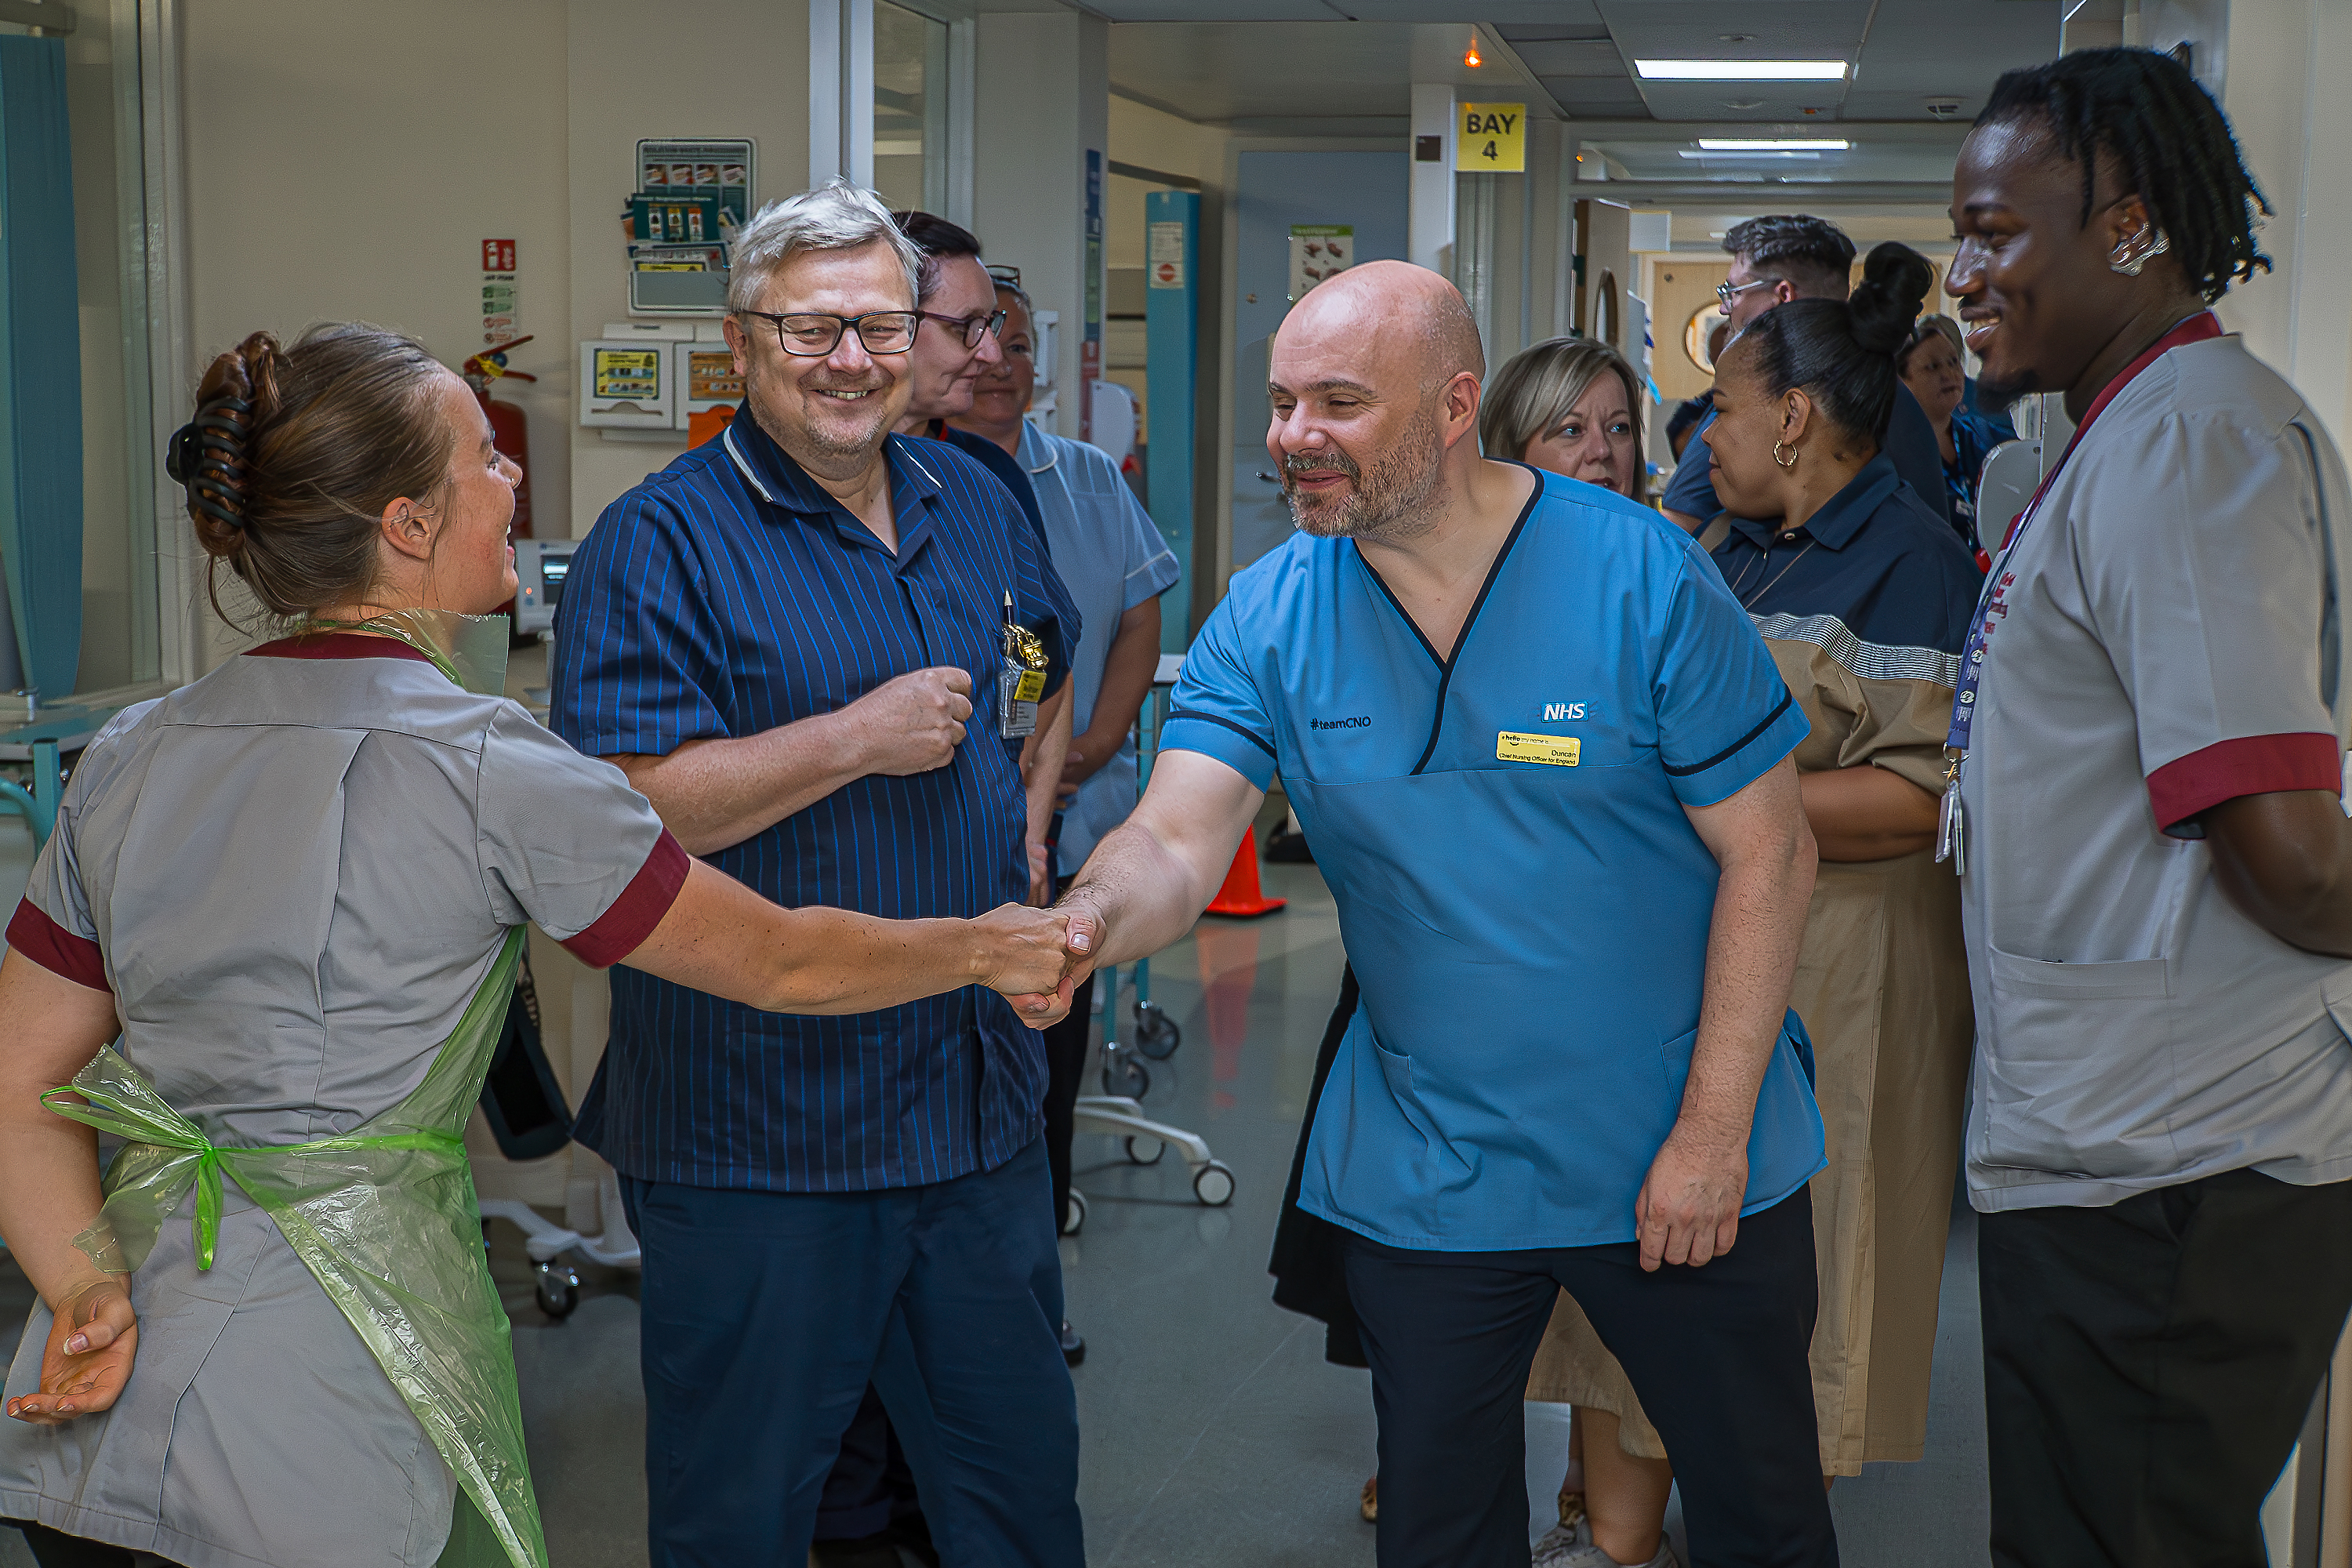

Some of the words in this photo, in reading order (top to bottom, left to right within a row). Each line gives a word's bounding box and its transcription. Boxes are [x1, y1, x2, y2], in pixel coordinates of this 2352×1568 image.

[1467, 113, 1517, 135] BAY
[1482, 140, 1498, 161] 4
[1544, 703, 1585, 720] NHS
[1310, 716, 1372, 731] #teamCNO
[1552, 750, 1577, 758] Duncan
